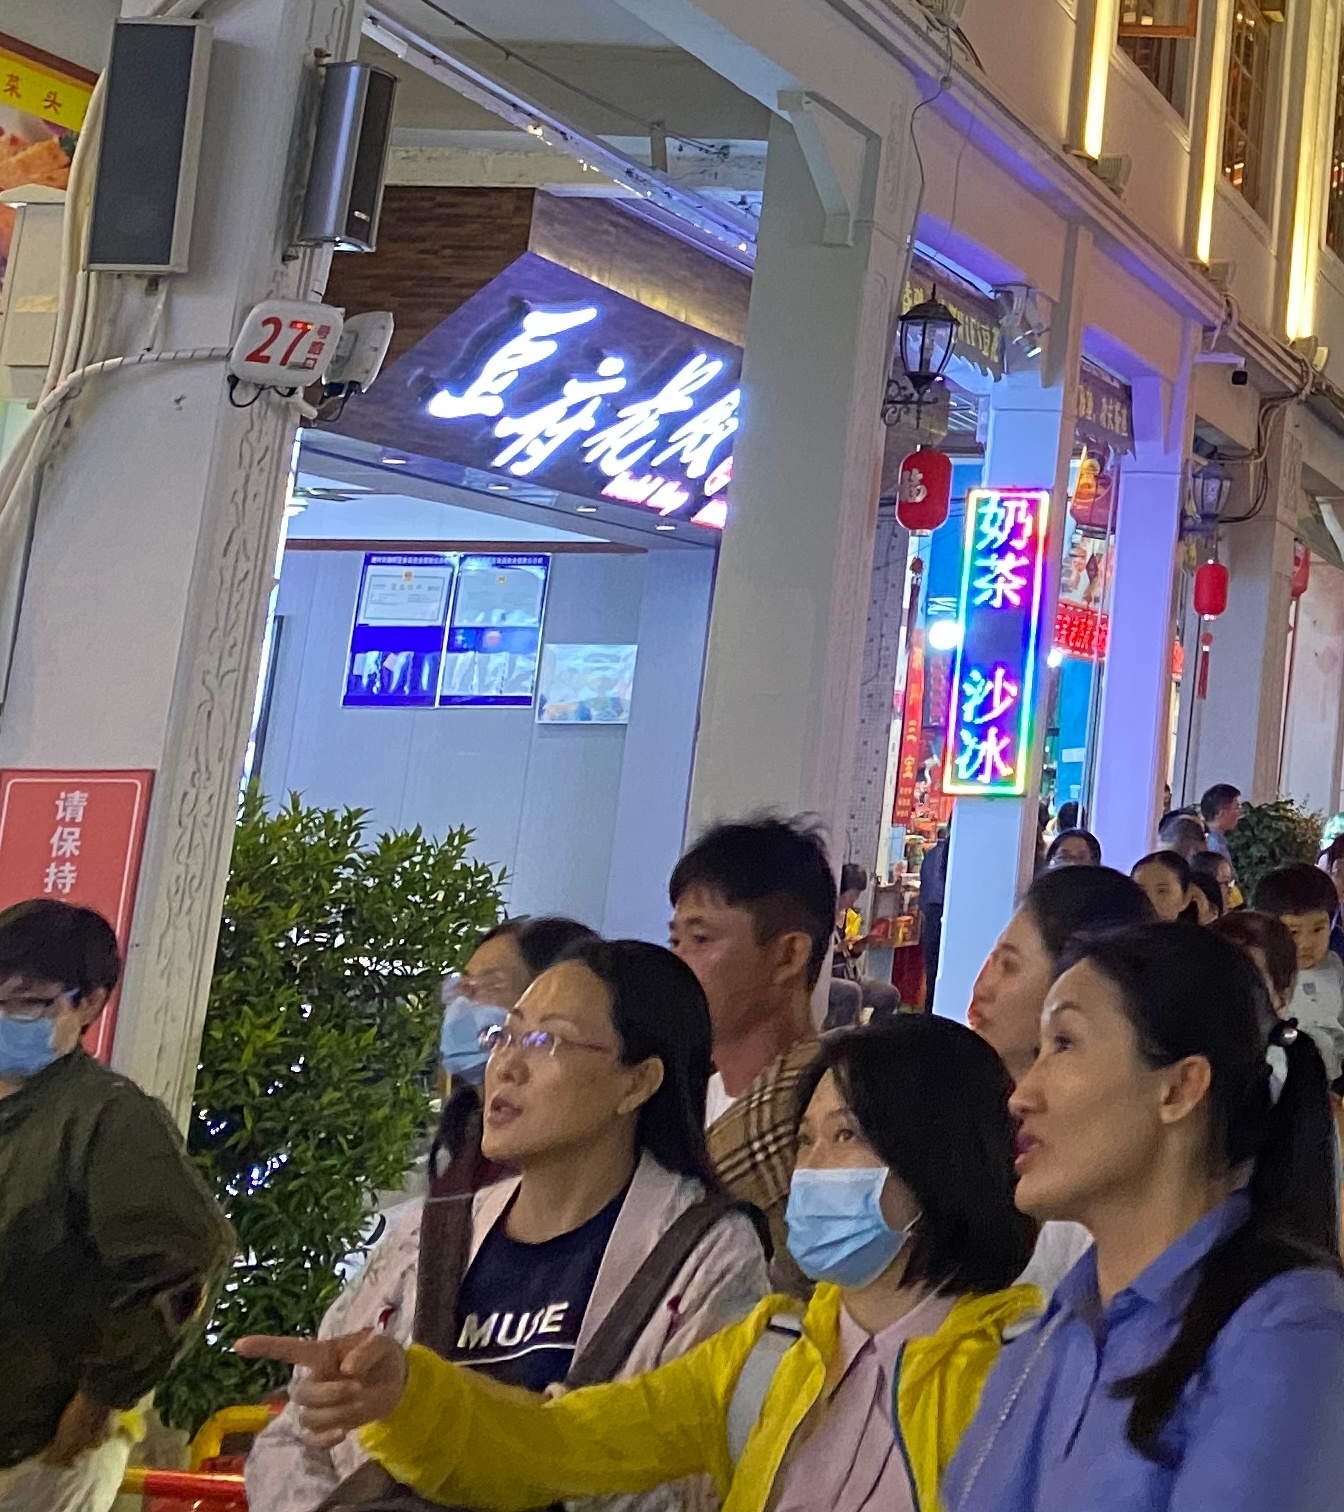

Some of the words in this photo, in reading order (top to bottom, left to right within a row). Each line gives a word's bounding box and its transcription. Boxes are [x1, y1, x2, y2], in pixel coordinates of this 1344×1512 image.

[244, 316, 314, 366] 27
[973, 496, 1032, 608] 奶茶
[955, 666, 1019, 784] 沙冰
[43, 790, 89, 895] 请保持
[456, 1301, 570, 1349] MUSE
